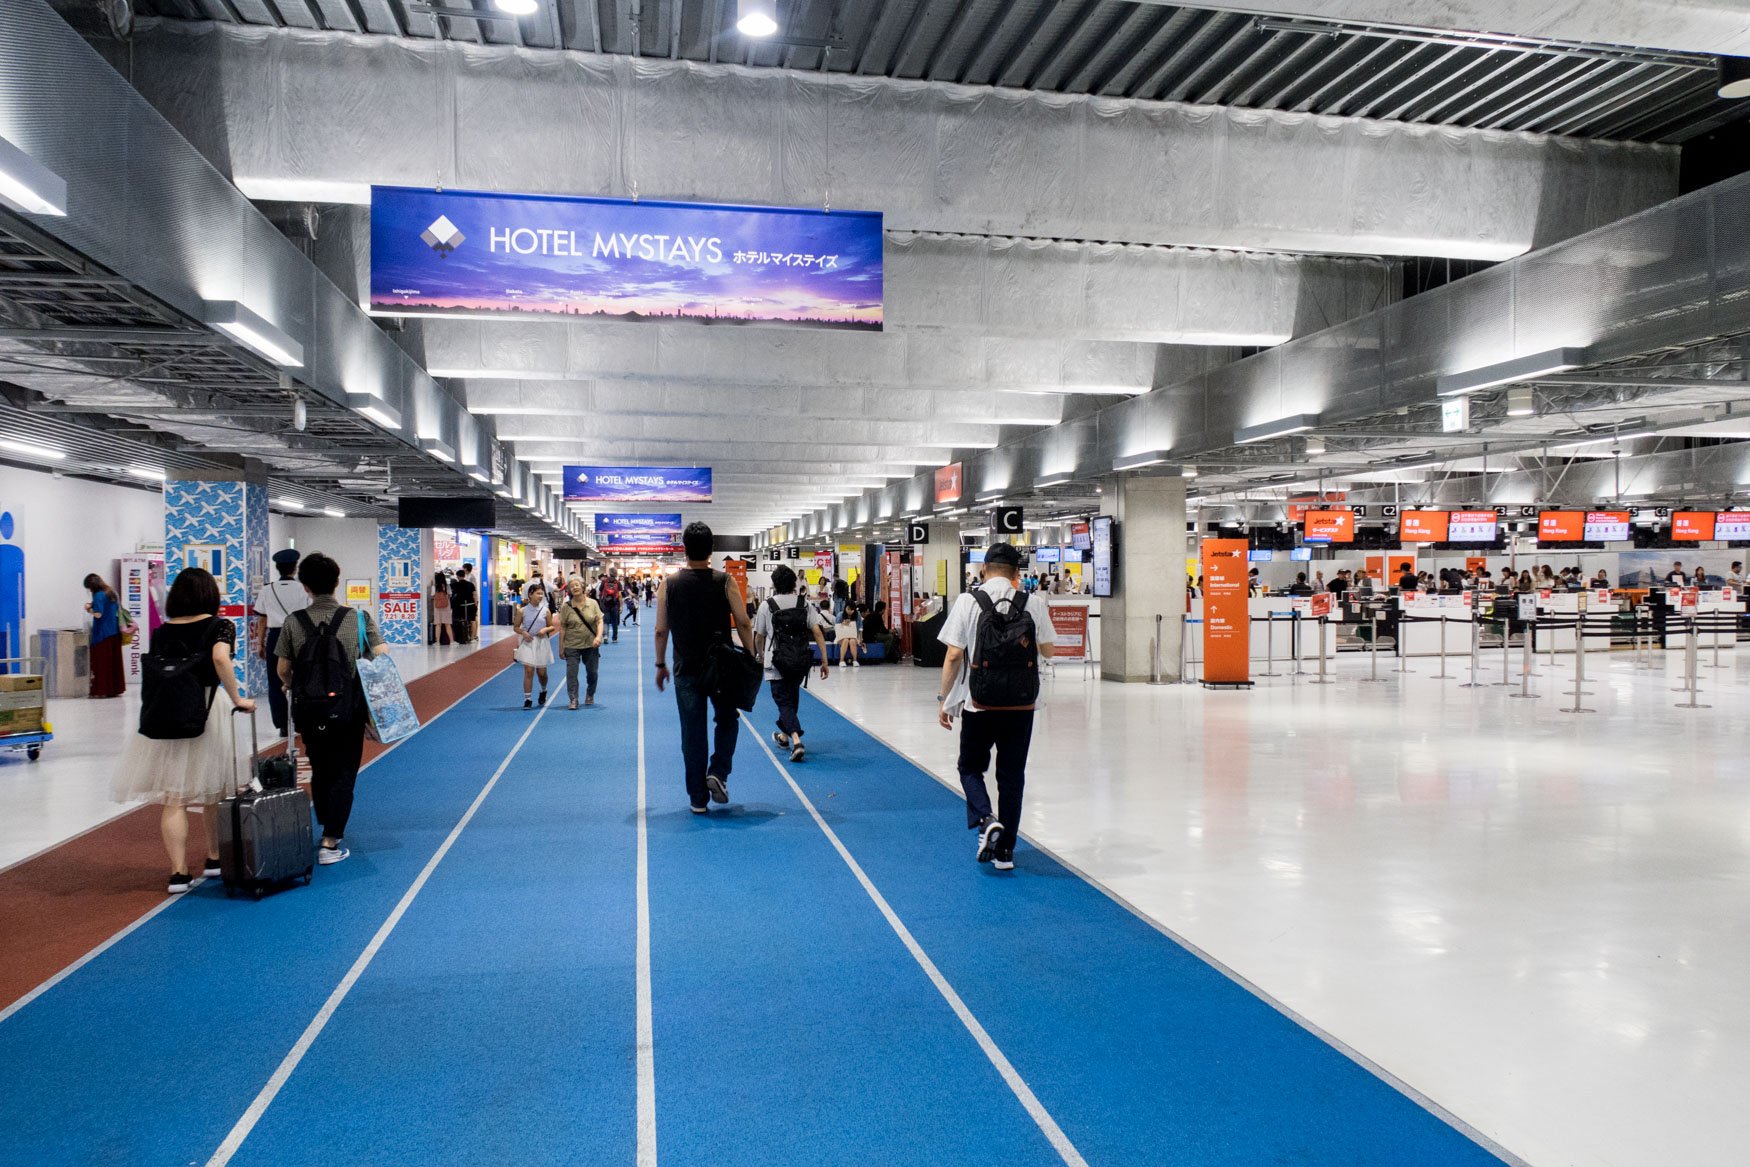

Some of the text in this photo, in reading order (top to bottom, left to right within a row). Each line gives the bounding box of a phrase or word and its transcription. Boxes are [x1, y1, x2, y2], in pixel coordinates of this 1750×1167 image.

[490, 227, 722, 263] HOTEL MYSTAYS
[733, 250, 838, 268] ホテルマイステイズ
[595, 476, 664, 486] HOTEL MYSTAYS
[1353, 506, 1365, 515] C1
[1383, 506, 1396, 516] C2
[1522, 507, 1534, 516] C4
[1655, 507, 1667, 516] C6
[1003, 511, 1018, 530] C
[913, 526, 925, 541] D
[773, 552, 779, 560] F
[791, 549, 797, 558] E
[384, 602, 416, 613] SALE
[131, 652, 140, 676] Bank
